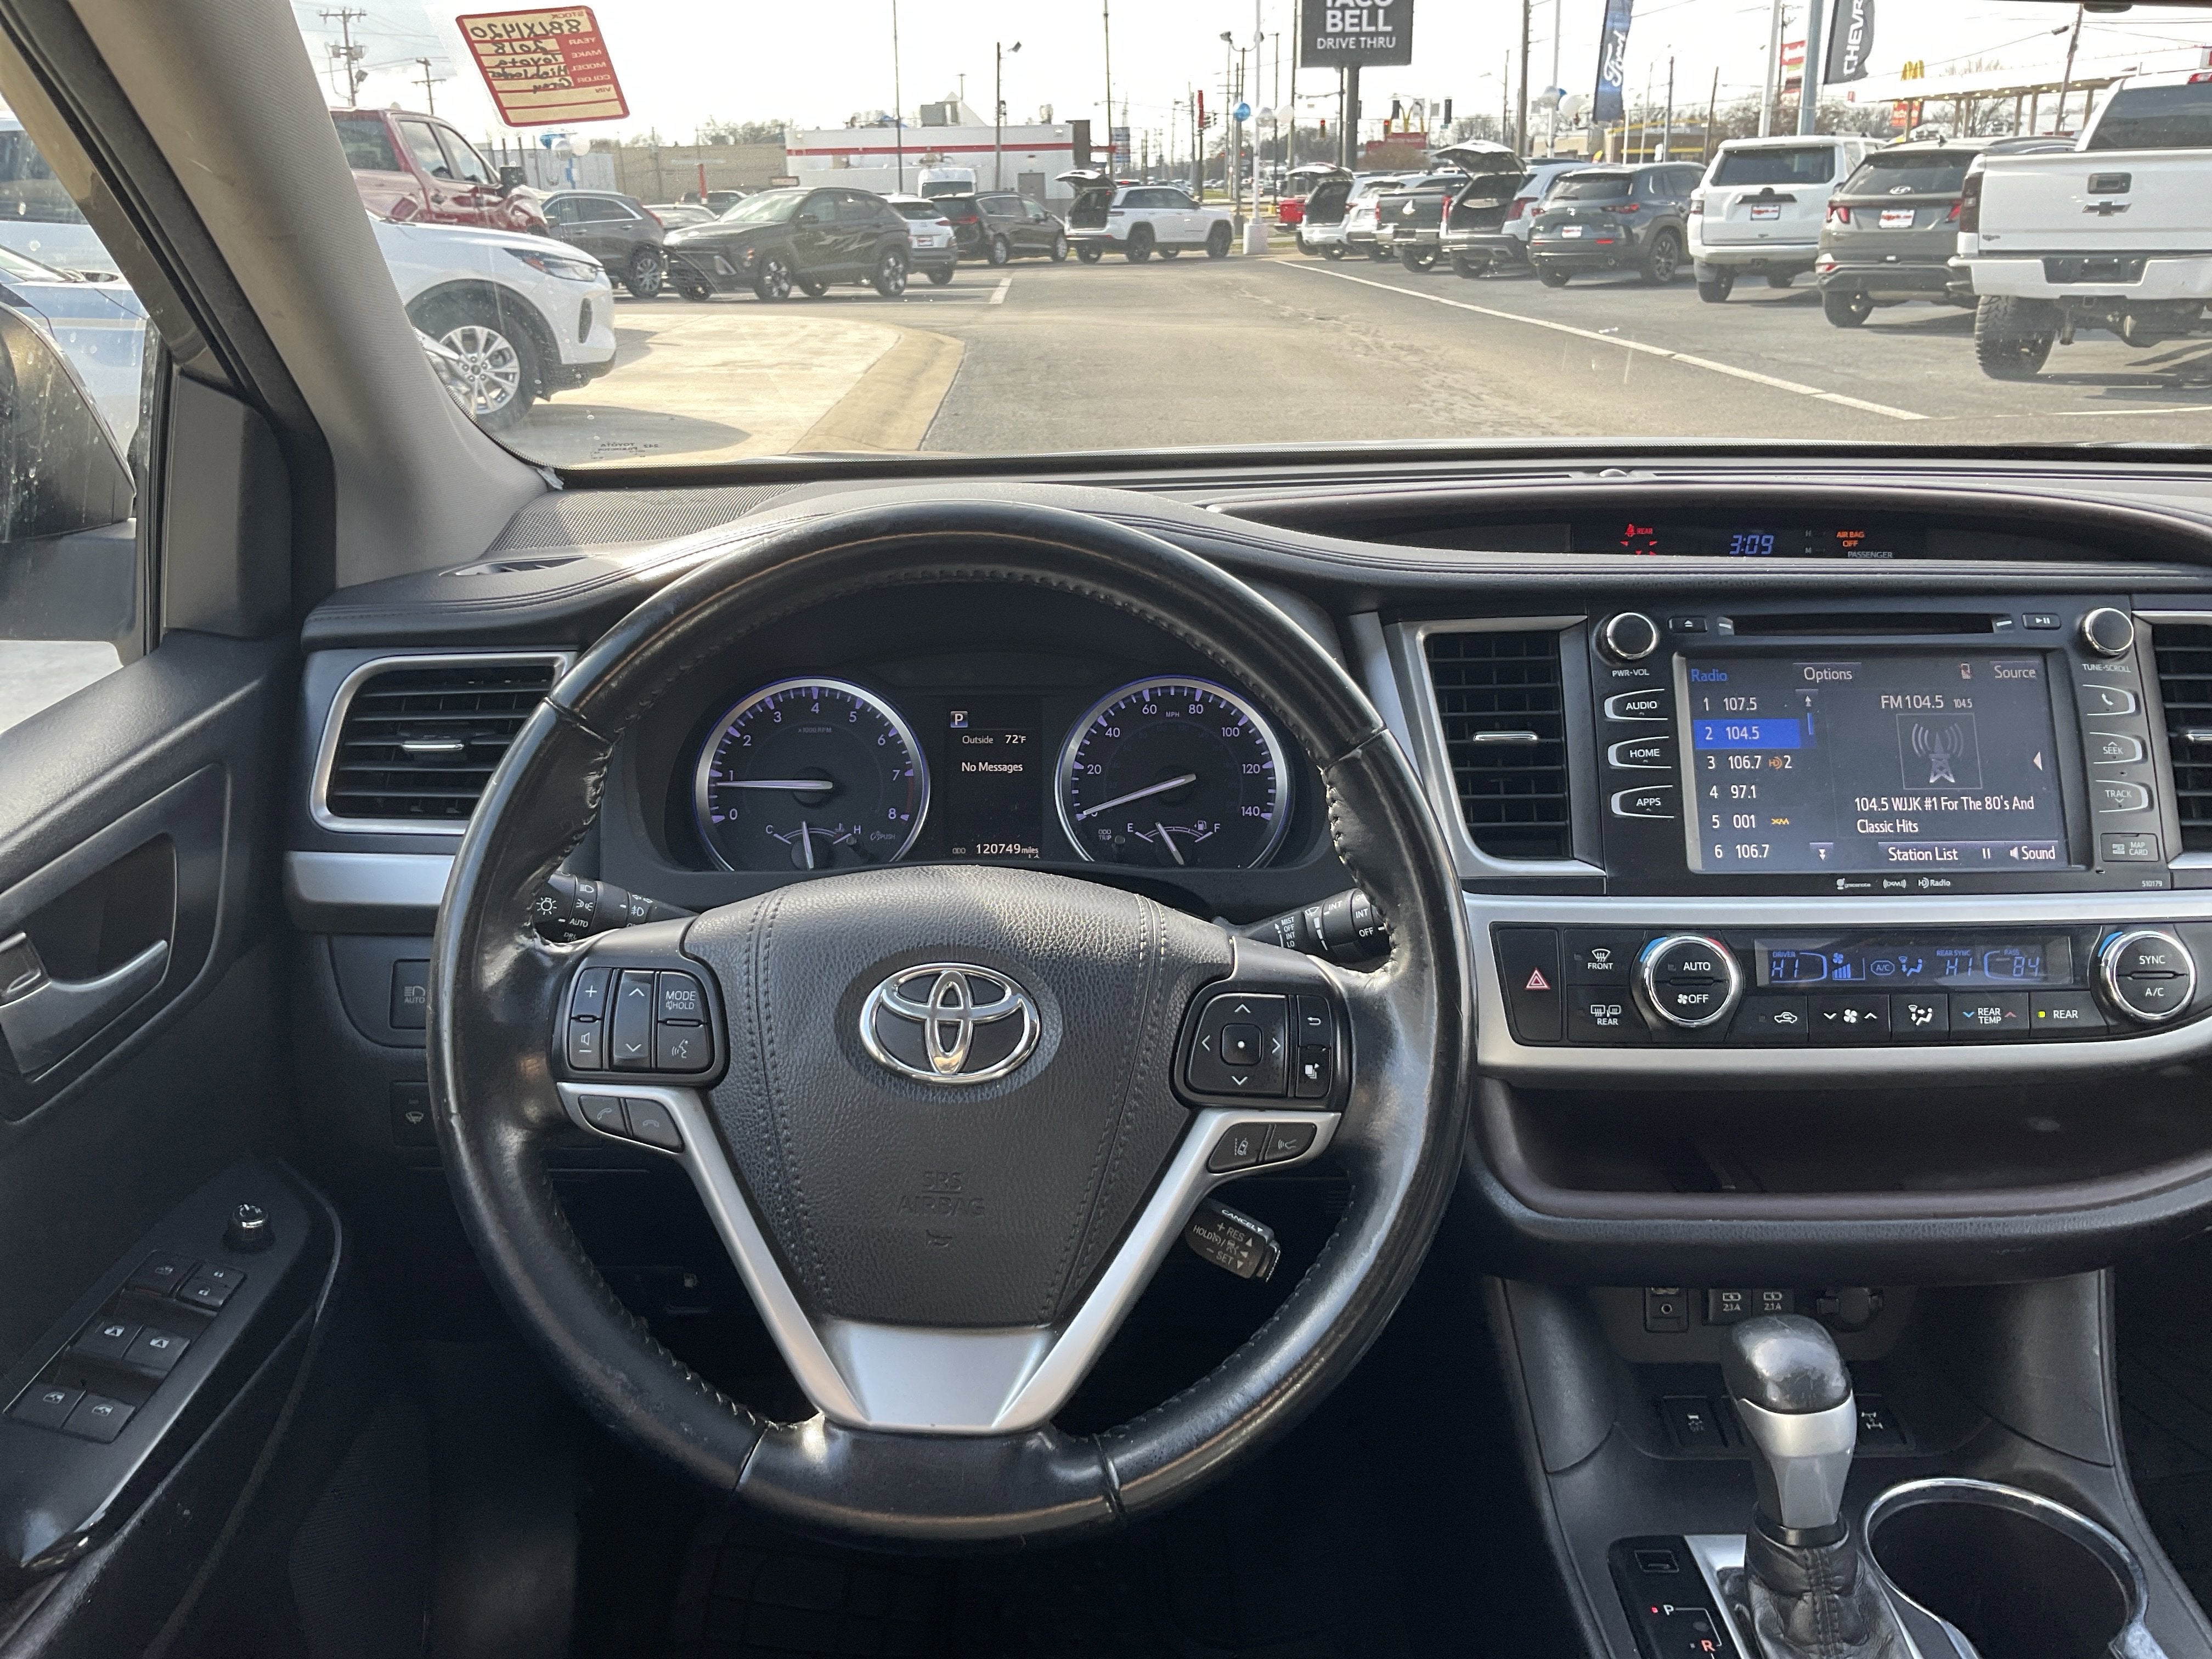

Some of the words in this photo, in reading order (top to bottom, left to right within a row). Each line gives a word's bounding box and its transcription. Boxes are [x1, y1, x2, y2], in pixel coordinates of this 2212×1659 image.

[1325, 9, 1392, 32] BELL
[1317, 37, 1356, 49] DRIVE
[1359, 37, 1396, 48] THRU
[1729, 534, 1774, 555] 3:09
[1691, 669, 1728, 682] Radio
[1804, 667, 1853, 683] Options
[1994, 665, 2036, 679] Source
[811, 702, 820, 713] 4
[1142, 704, 1158, 714] 60
[1188, 704, 1204, 714] 80
[1626, 701, 1657, 710] AUDIO
[1703, 698, 1709, 711] 1
[1723, 697, 1757, 711] 107.5
[774, 712, 782, 723] 3
[849, 712, 857, 723] 5
[955, 714, 963, 725] P
[1105, 727, 1120, 737] 40
[1221, 727, 1240, 737] 100
[1705, 727, 1713, 740] 2
[1725, 726, 1760, 740] 104.5
[743, 735, 752, 746] 2
[878, 735, 886, 746] 6
[962, 735, 994, 744] Outside
[1629, 748, 1660, 758] HOME
[2103, 747, 2124, 755] SEEK
[962, 762, 976, 772] No
[979, 761, 1023, 774] Messages
[1707, 757, 1715, 769] 3
[1728, 755, 1761, 769] 106.7
[892, 769, 900, 780] 7
[1087, 764, 1102, 775] 20
[1242, 764, 1260, 774] 120
[729, 770, 733, 781] 1
[1709, 786, 1718, 799] 4
[1730, 785, 1757, 799] 97.1
[2105, 789, 2132, 798] TRACK
[1636, 798, 1661, 806] APPS
[1854, 797, 1888, 811] 104.5
[1892, 797, 1922, 811] WJJK
[1924, 798, 1938, 811] #1
[1942, 797, 1958, 810] For
[1961, 797, 1982, 810] The
[1985, 795, 2009, 810] 80's
[2012, 796, 2034, 810] And
[729, 808, 738, 820] 0
[888, 808, 896, 819] 8
[1241, 806, 1260, 816] 140
[1712, 815, 1720, 828] 5
[1733, 815, 1756, 828] 001
[1857, 819, 1894, 833] Classic
[1896, 819, 1918, 833] Hits
[765, 825, 774, 835] C
[853, 825, 861, 834] H
[1127, 823, 1133, 832] E
[1214, 823, 1221, 833] F
[1714, 845, 1723, 858] 6
[1736, 844, 1769, 858] 106.7
[1888, 847, 1932, 861] Station
[1936, 847, 1959, 861] List
[2022, 845, 2056, 860] Sound
[1329, 900, 1342, 911] INT
[1355, 909, 1368, 918] INT
[569, 918, 588, 928] AUTO
[1281, 916, 1294, 926] MIST
[1284, 924, 1294, 932] OFF
[1359, 927, 1374, 937] OFF
[1286, 932, 1295, 940] INT
[2139, 955, 2165, 964] SYNC
[1683, 962, 1711, 971] AUTO
[1876, 964, 1890, 972] A/C
[2012, 956, 2040, 977] 84
[665, 991, 696, 1000] MODE
[2146, 988, 2164, 997] A/C
[1688, 994, 1709, 1003] OFF
[1978, 1008, 2000, 1016] REAR
[2053, 1010, 2078, 1019] REAR
[1978, 1016, 2001, 1024] TEMP
[1222, 1209, 1256, 1231] CANCEL
[1193, 1225, 1212, 1239] HOLD
[1227, 1227, 1245, 1242] RES
[1216, 1251, 1234, 1265] SET
[1663, 1605, 1674, 1616] P
[1701, 1640, 1716, 1652] R
